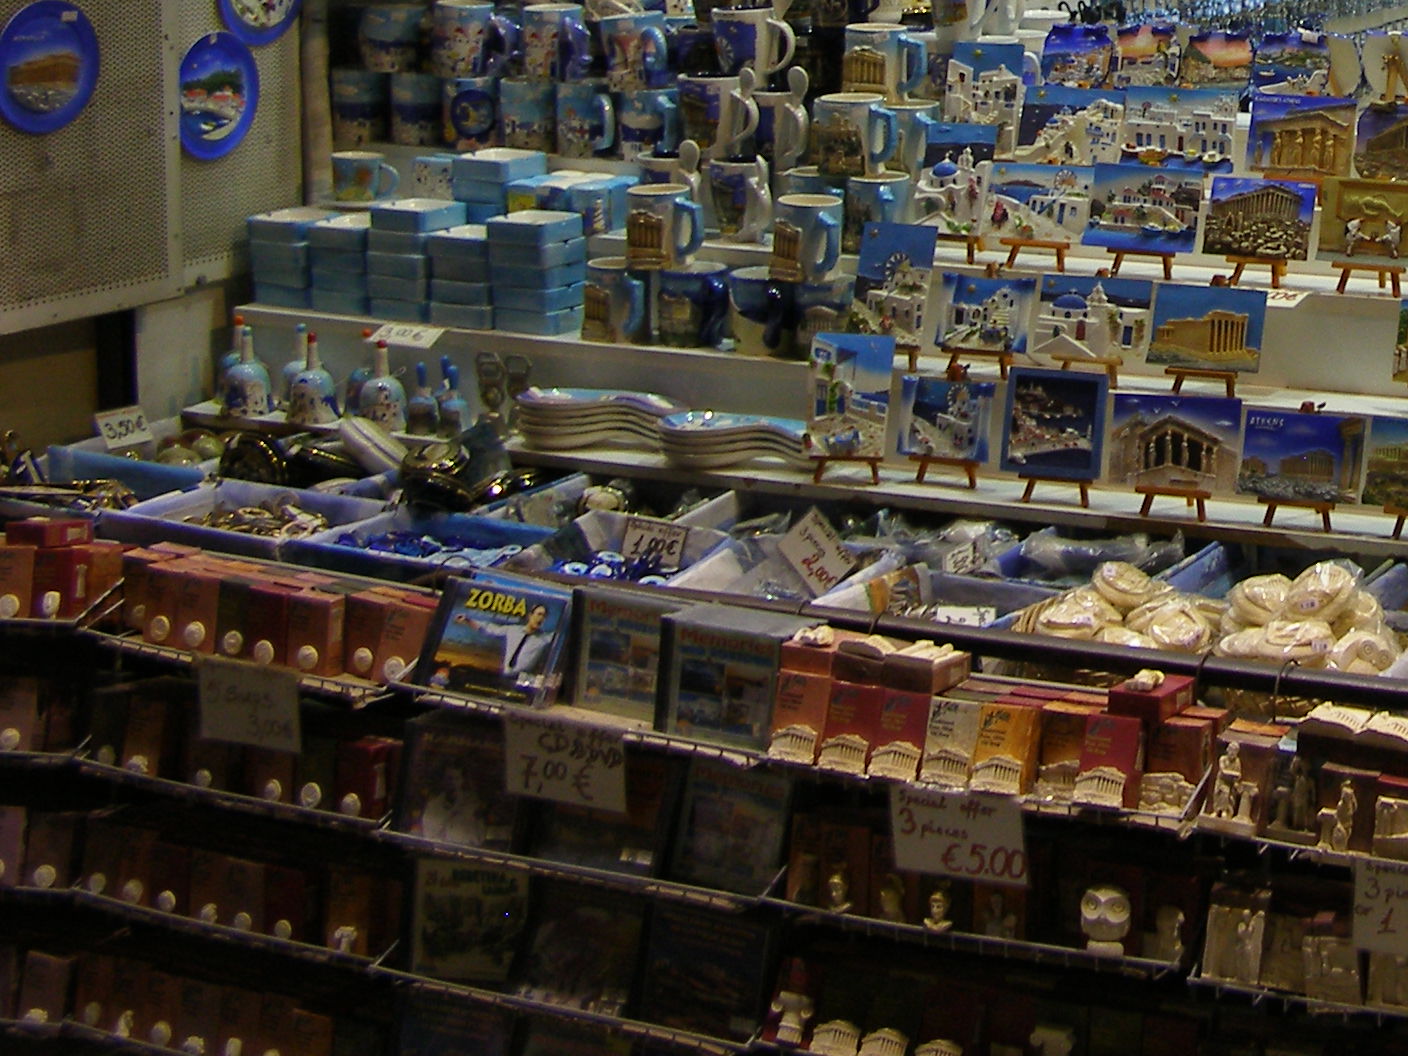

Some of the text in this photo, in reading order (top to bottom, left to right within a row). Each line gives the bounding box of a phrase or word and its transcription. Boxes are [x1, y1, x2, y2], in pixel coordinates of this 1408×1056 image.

[1249, 416, 1285, 429] ATHENS
[464, 587, 527, 617] ZORBA
[538, 732, 569, 753] CD
[898, 806, 918, 836] 3
[941, 843, 1027, 880] €5.00
[1363, 876, 1381, 900] 3
